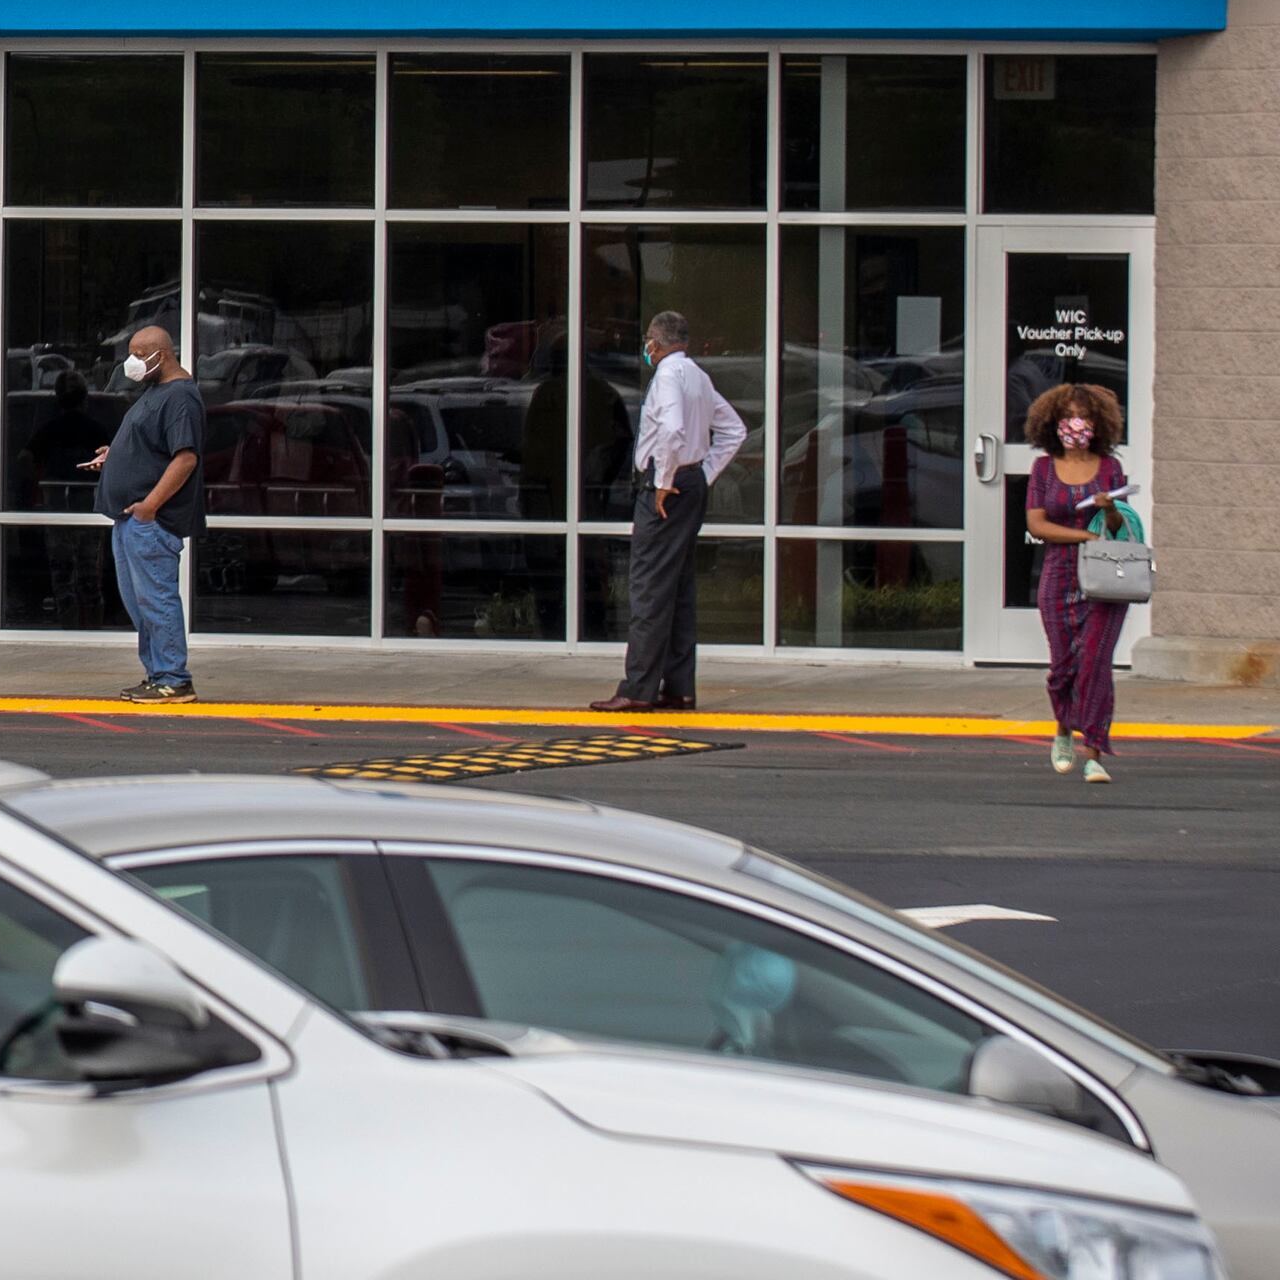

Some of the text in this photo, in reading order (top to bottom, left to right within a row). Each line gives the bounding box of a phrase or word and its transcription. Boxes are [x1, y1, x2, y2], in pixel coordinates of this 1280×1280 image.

[1055, 309, 1087, 324] WIC
[1017, 326, 1125, 344] Voucher Pick-up
[1055, 343, 1087, 360] Only
